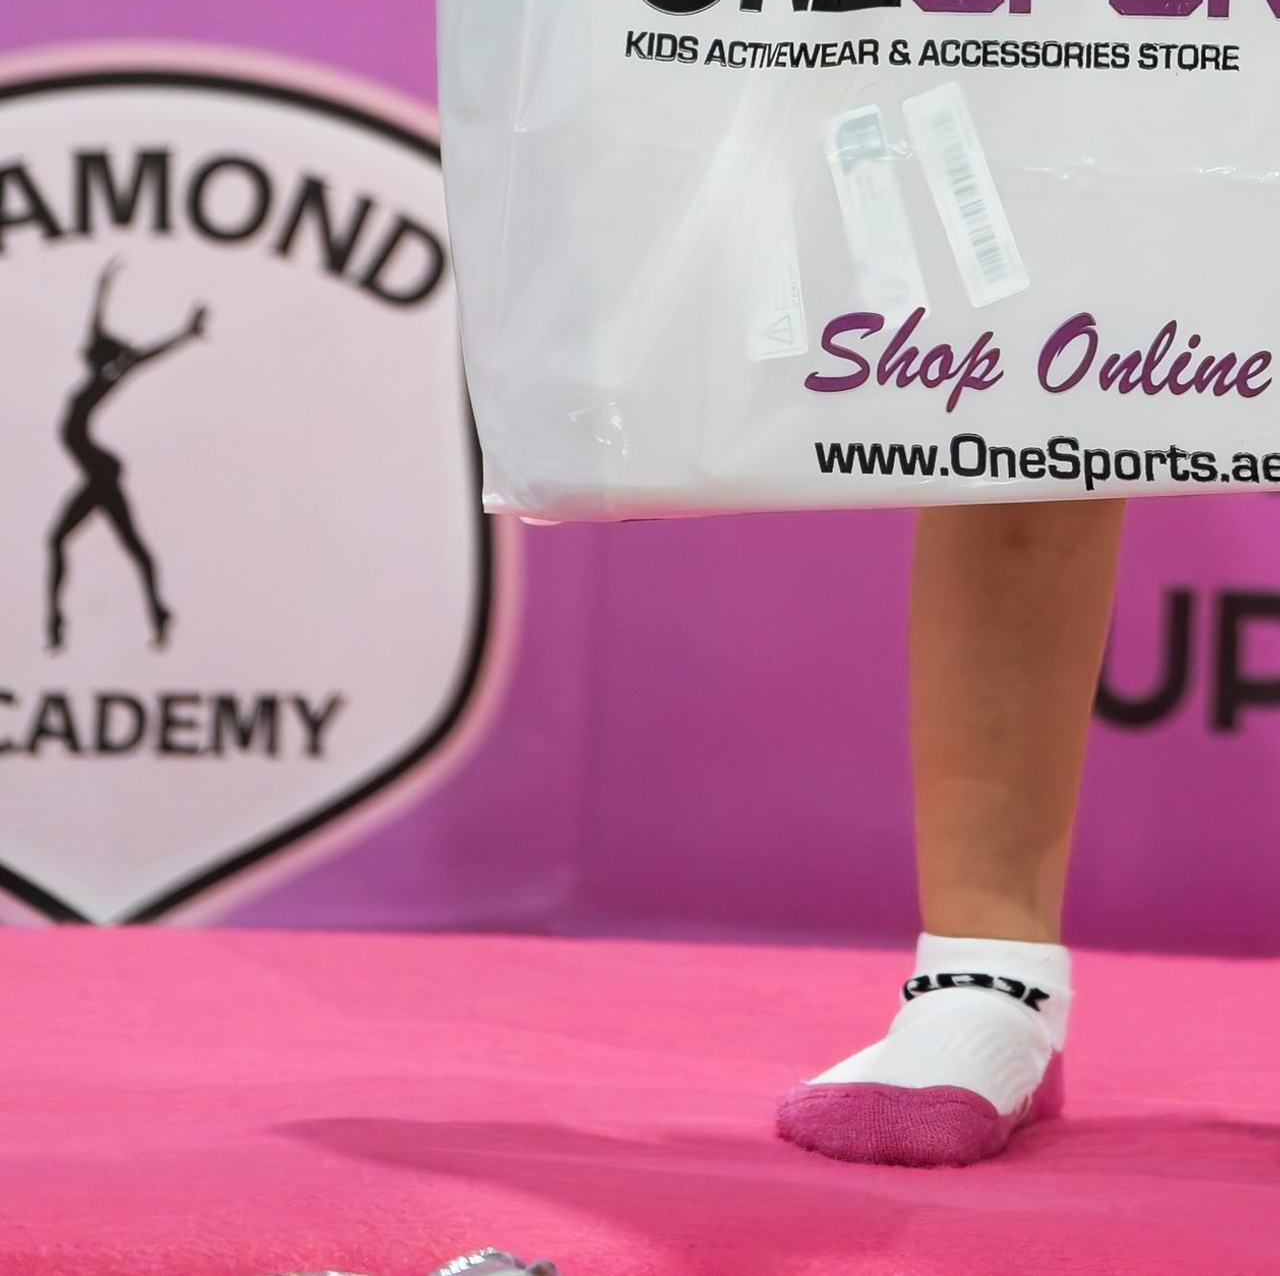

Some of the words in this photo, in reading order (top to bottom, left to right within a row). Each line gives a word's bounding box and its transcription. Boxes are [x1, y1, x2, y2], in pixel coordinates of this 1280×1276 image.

[625, 30, 699, 63] KIDS
[703, 38, 879, 70] ACTIVEWEAR
[888, 39, 912, 66] &
[917, 39, 1130, 69] ACCESSORIES
[1137, 42, 1240, 72] STORE
[804, 306, 1004, 413] Shop
[1037, 312, 1273, 399] Online
[0, 688, 345, 759] ADEMY
